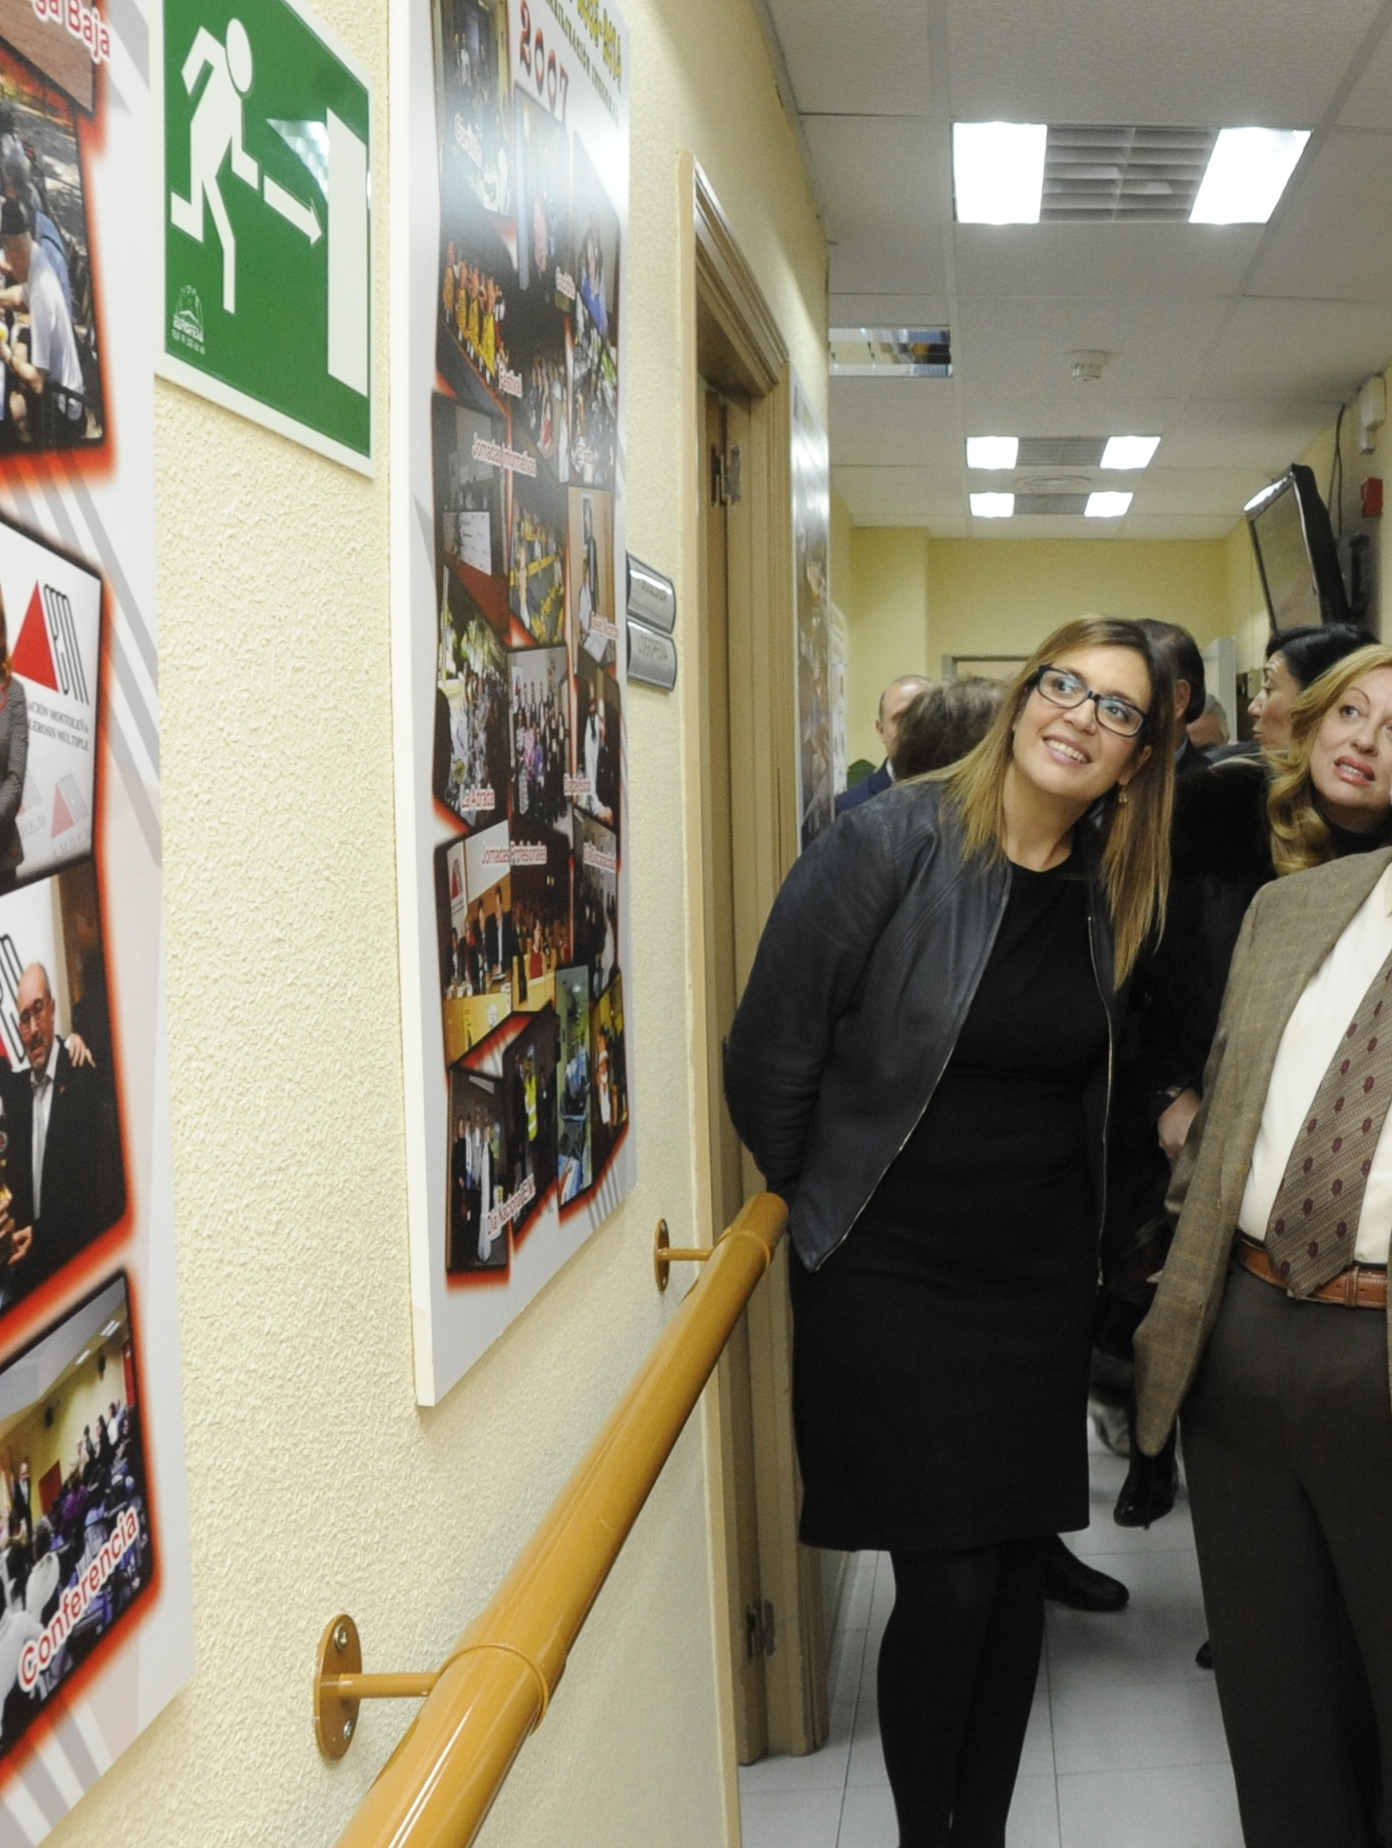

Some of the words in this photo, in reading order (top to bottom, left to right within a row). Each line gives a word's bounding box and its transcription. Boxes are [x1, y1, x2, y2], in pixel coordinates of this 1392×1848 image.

[68, 0, 111, 58] Baja
[519, 0, 569, 122] 2007
[473, 434, 502, 466] Jornadas
[29, 719, 57, 739] LEROSIS
[50, 707, 89, 735] MOSTOLEÑA
[482, 843, 510, 865] Jornadas
[21, 1511, 138, 1687] Conferencia
